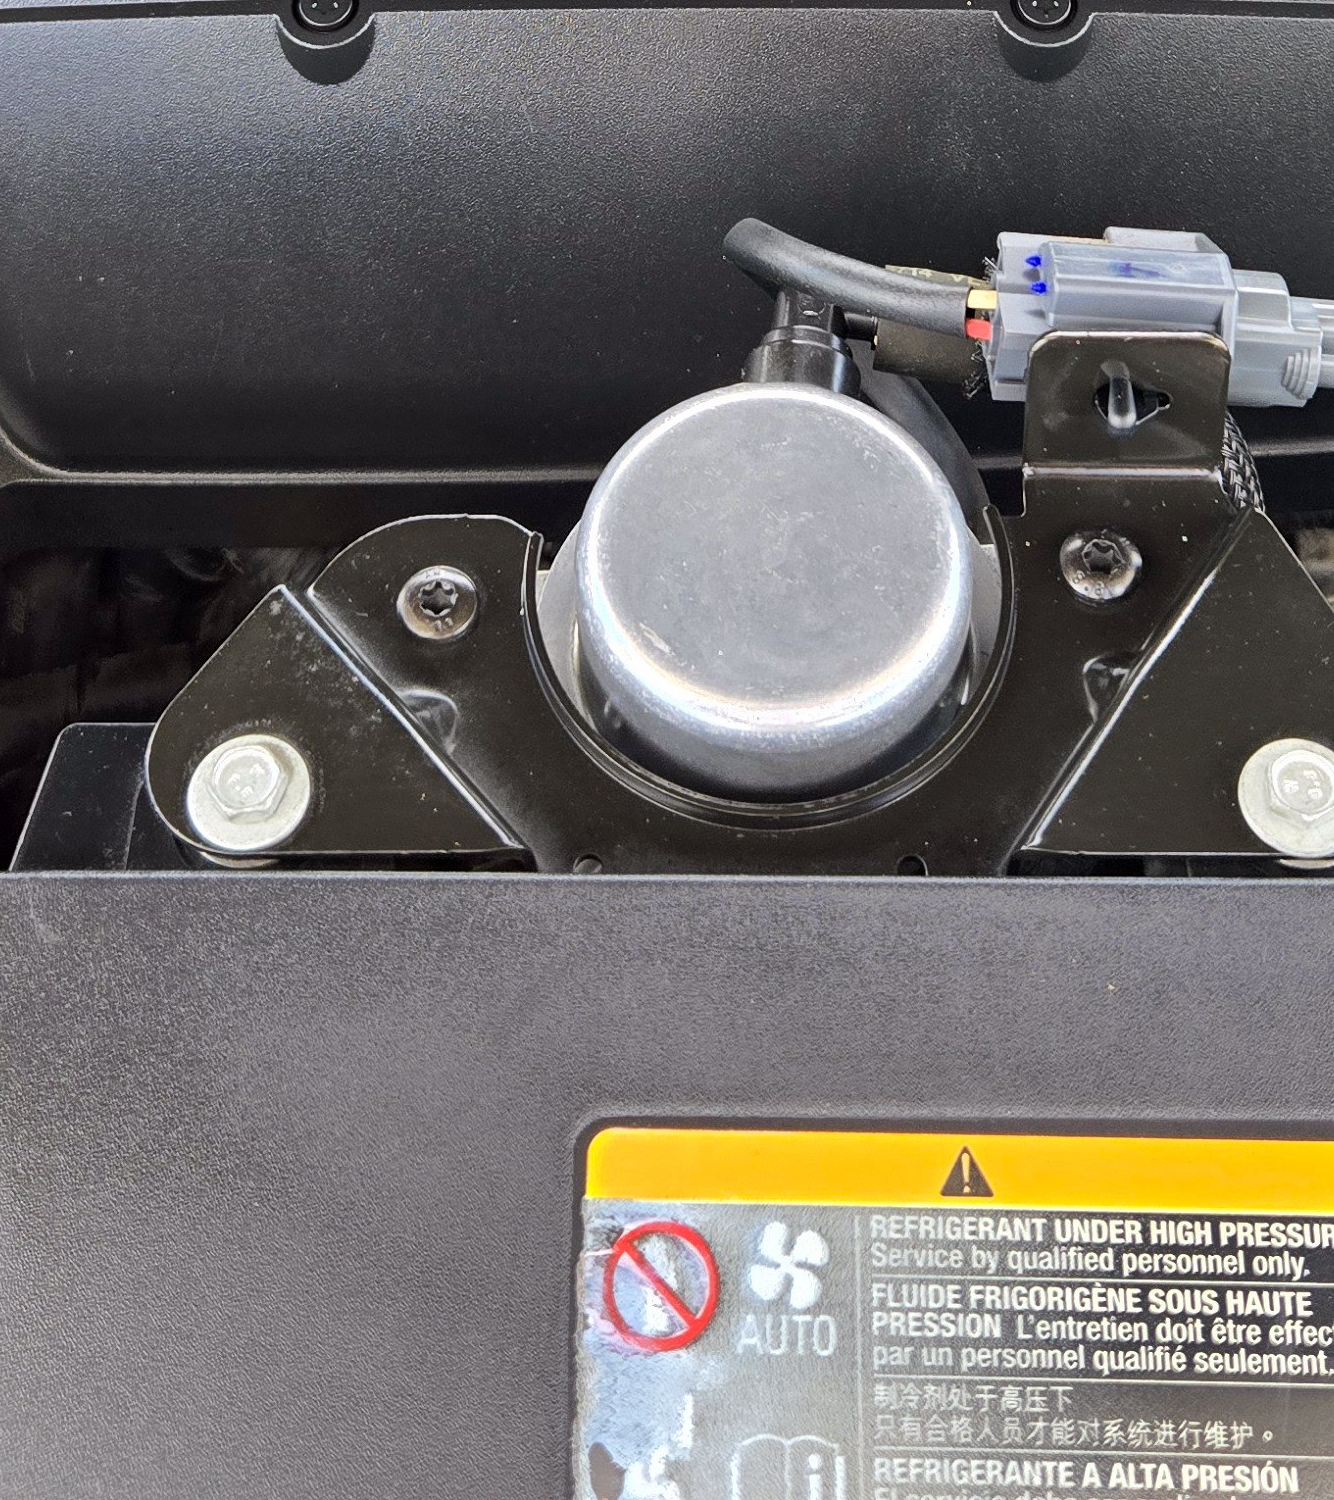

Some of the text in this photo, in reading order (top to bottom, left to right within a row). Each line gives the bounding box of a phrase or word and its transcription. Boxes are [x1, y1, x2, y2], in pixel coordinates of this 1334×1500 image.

[870, 1215, 1047, 1241] REFRIGERANT
[1054, 1218, 1143, 1244] UNDER
[1149, 1220, 1213, 1246] HIGH
[871, 1242, 1311, 1281] Service by qualified personnel only.
[872, 1282, 1314, 1318] FLUIDE FRIGORIGÈNE SOUS HAUTE
[736, 1313, 837, 1356] AUTO
[872, 1311, 1002, 1339] PRESSION
[1017, 1314, 1149, 1343] L'entretien
[1155, 1317, 1205, 1343] doit
[1211, 1318, 1262, 1346] être
[872, 1345, 915, 1371] par
[922, 1346, 954, 1368] un
[961, 1344, 1085, 1372] personnel
[1092, 1345, 1187, 1376] qualifié
[873, 1382, 1074, 1413] 制冷剂处于高压下
[873, 1414, 1274, 1450] 只有合格人员才能对系统进行维护。
[873, 1457, 1076, 1487] REFRIGERANTE
[1081, 1461, 1102, 1489] A
[1108, 1462, 1175, 1491] ALTA
[1181, 1460, 1301, 1494] PRESIÓN
